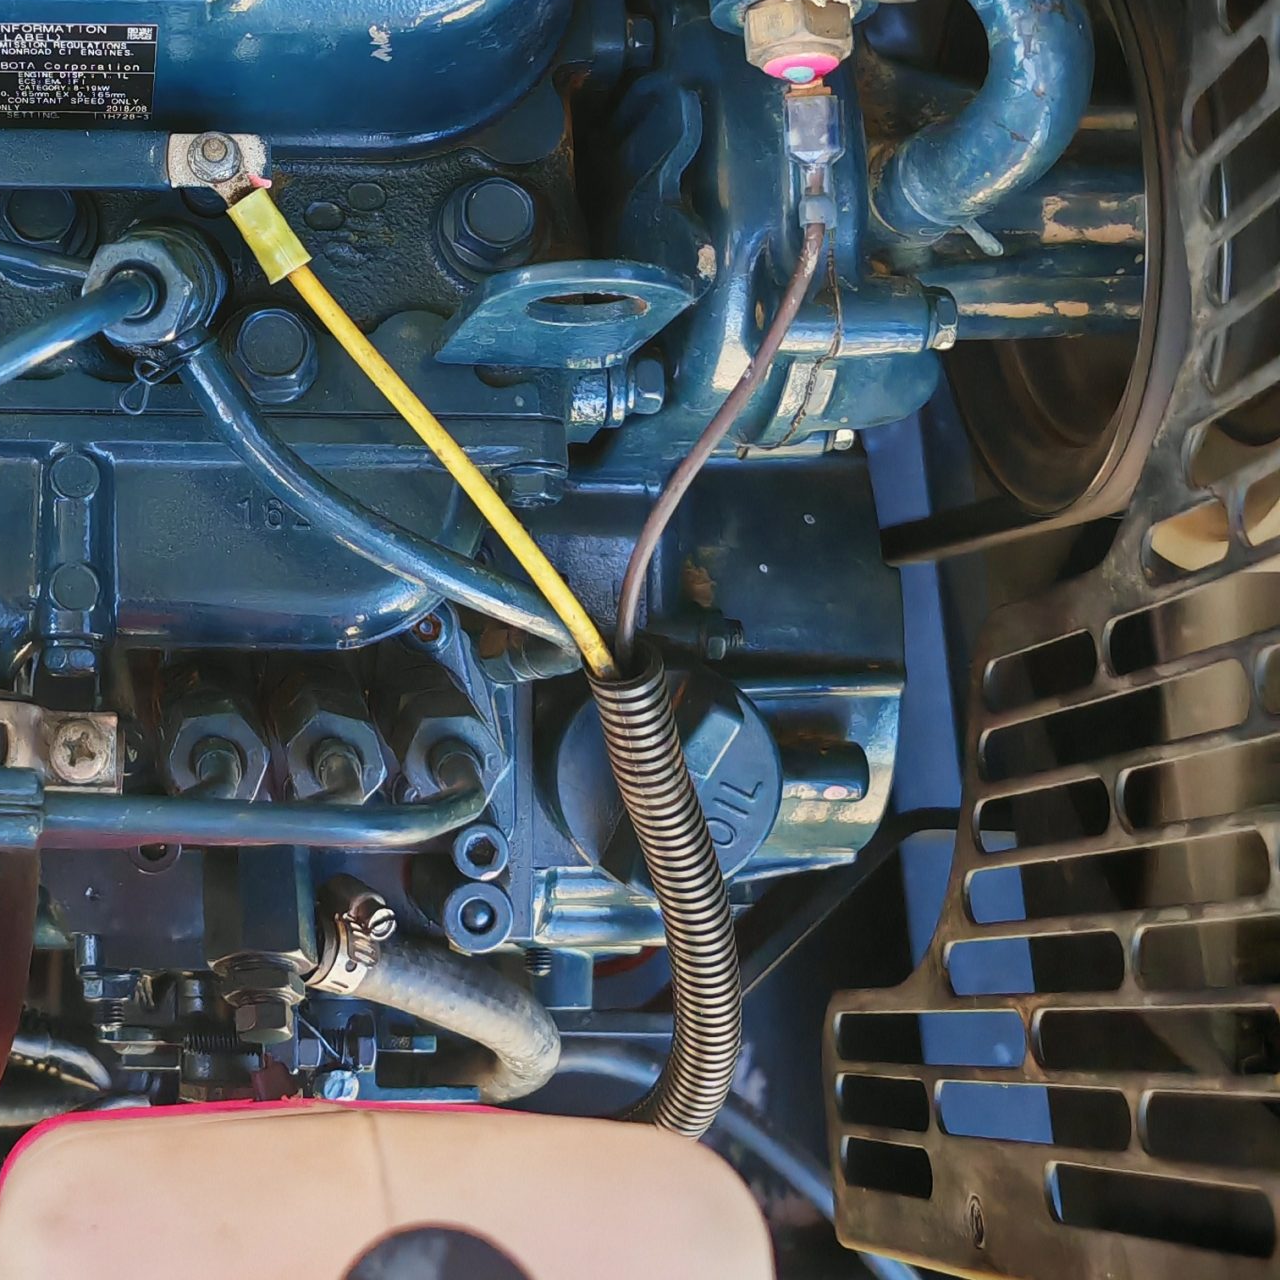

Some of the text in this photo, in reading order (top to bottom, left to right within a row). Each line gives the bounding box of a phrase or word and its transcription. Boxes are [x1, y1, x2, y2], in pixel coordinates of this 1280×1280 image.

[4, 33, 61, 42] LABEL)
[53, 40, 127, 50] REGULATIONS
[2, 48, 52, 56] NONROAD
[58, 48, 72, 56] CI
[44, 62, 140, 72] Corporation
[111, 98, 140, 106] ONLY
[705, 780, 764, 849] OIL
